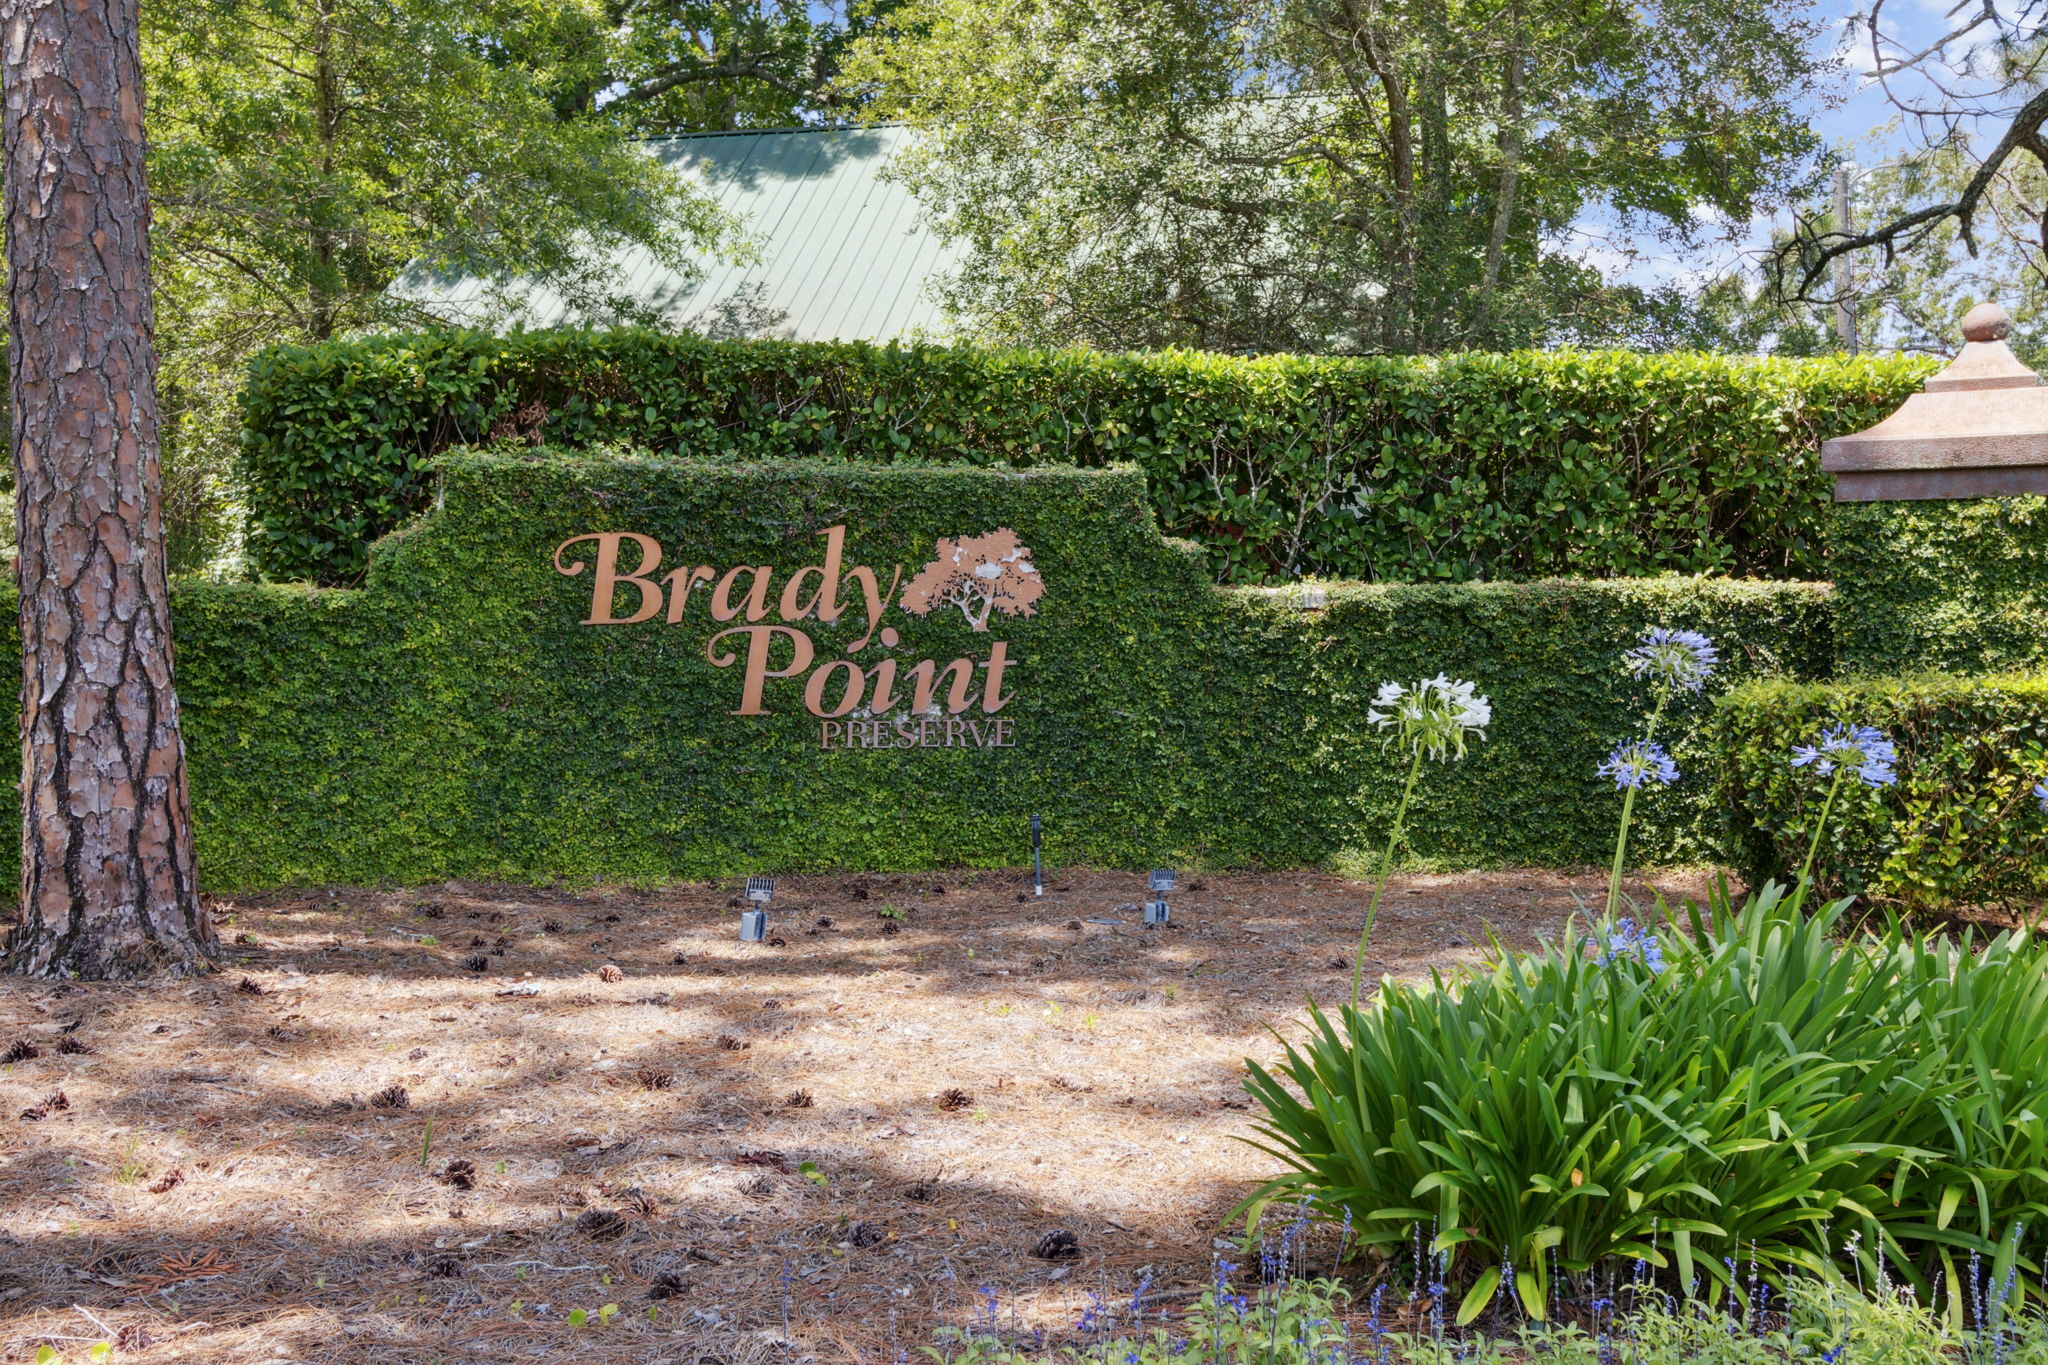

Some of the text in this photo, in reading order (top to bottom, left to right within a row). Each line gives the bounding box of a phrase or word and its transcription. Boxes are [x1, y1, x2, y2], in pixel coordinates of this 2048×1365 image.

[554, 525, 900, 654] Brady
[707, 625, 1018, 718] Point
[821, 719, 1016, 750] PRESERVE
